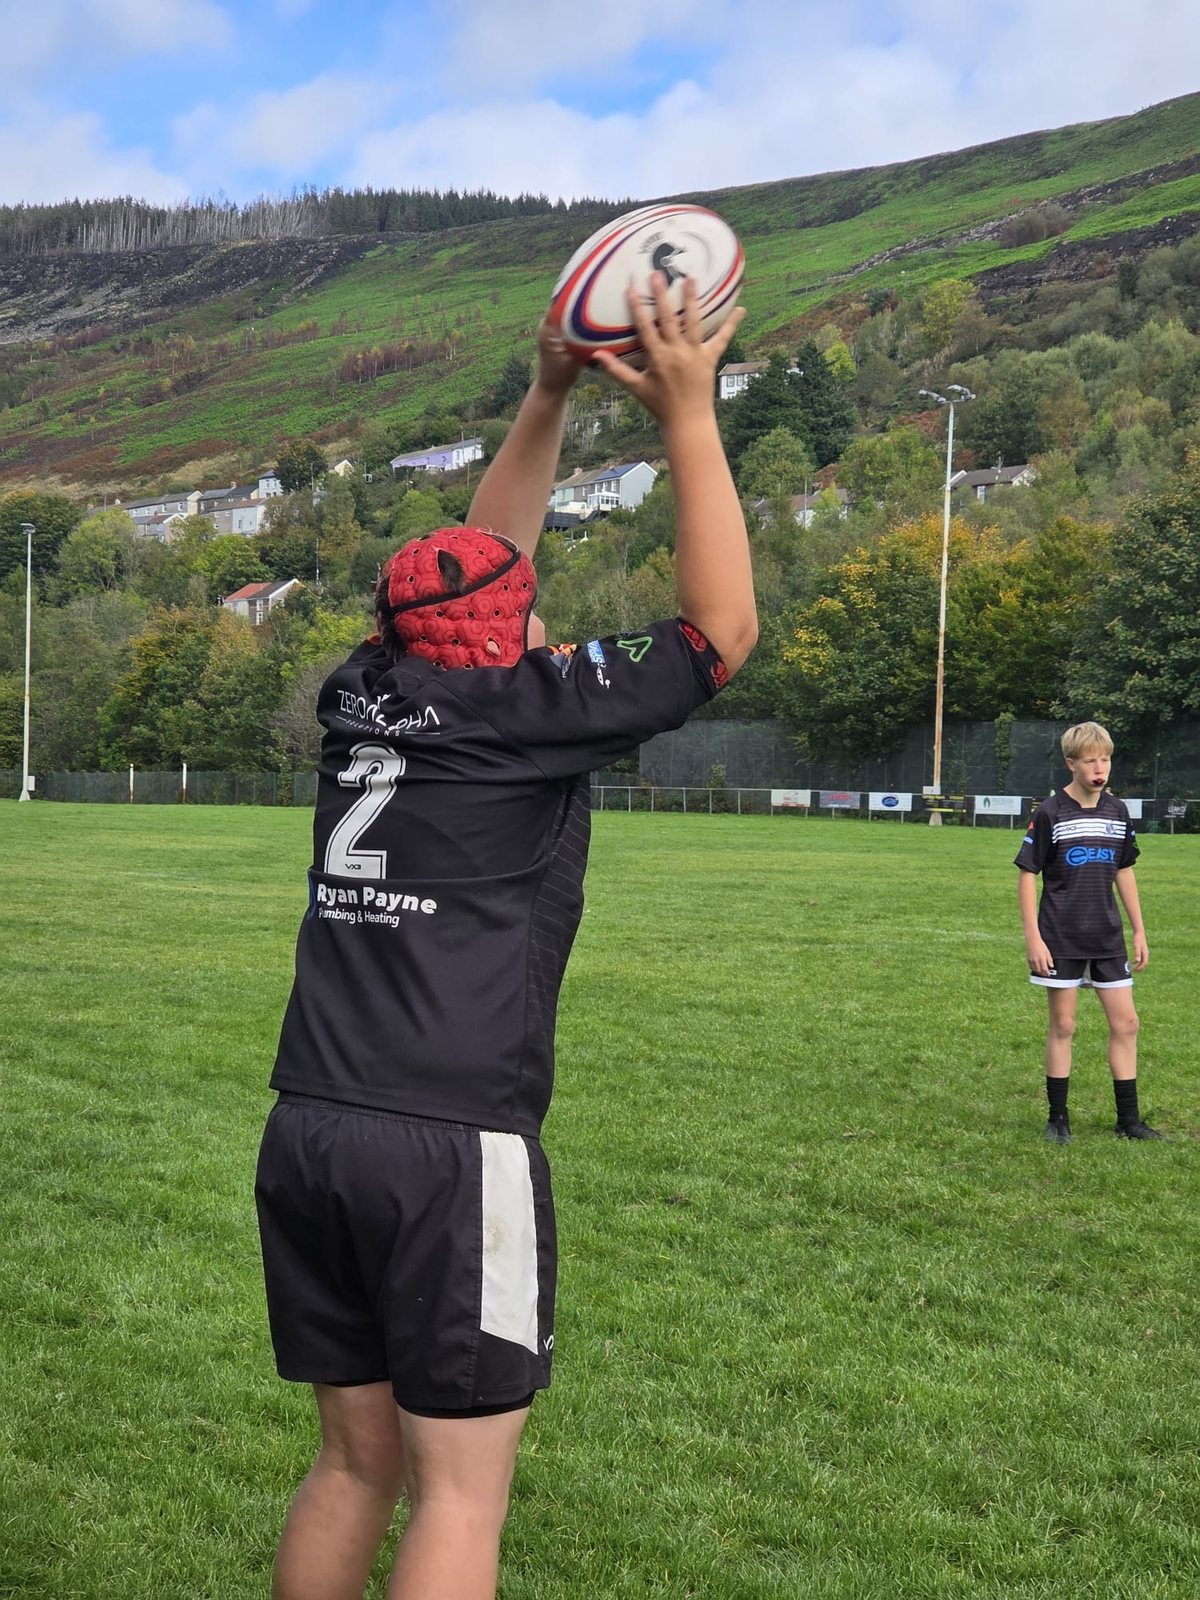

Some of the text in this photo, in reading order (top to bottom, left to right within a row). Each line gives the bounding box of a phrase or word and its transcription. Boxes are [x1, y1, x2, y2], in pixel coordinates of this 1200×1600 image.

[324, 740, 407, 880] 2
[316, 883, 438, 914] Ryan Payne
[318, 906, 400, 928] Pumbing & Heating
